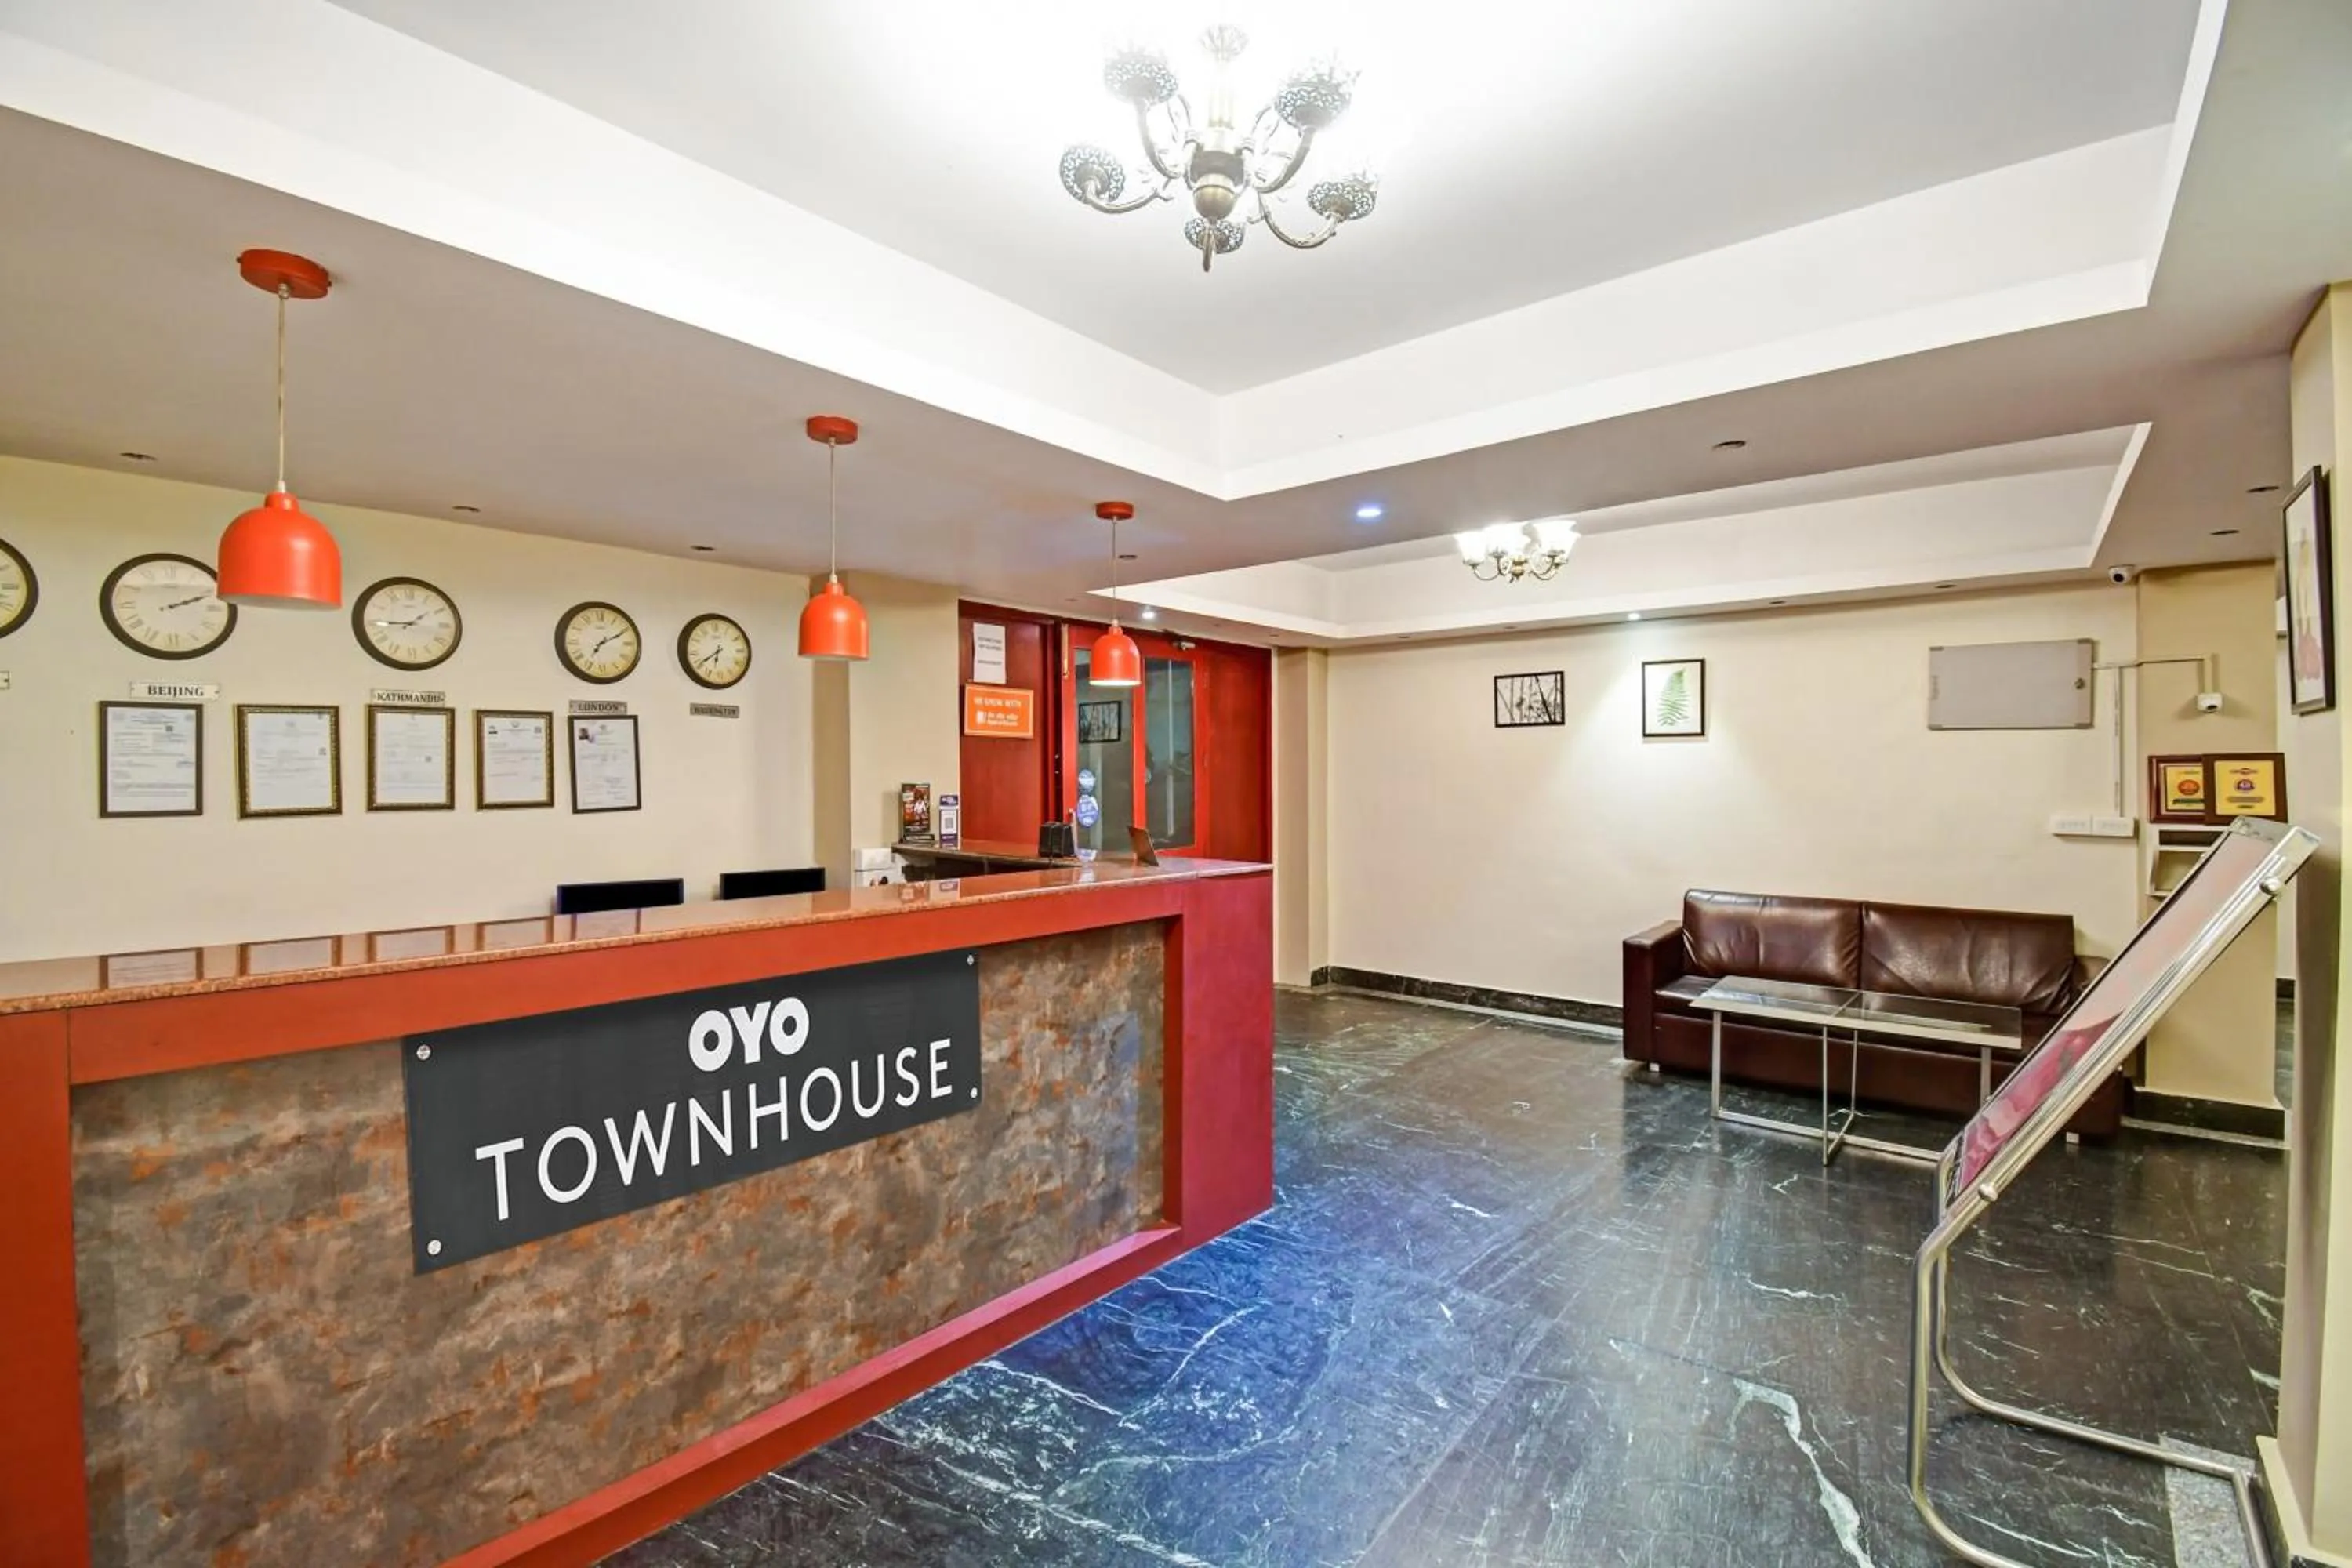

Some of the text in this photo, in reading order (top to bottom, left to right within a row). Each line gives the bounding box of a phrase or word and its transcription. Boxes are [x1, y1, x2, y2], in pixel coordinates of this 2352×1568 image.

[147, 685, 204, 697] BEIJING
[377, 692, 441, 703] KATHMANDU
[688, 996, 810, 1073] OYO
[475, 1038, 952, 1221] TOWNHOUSE
